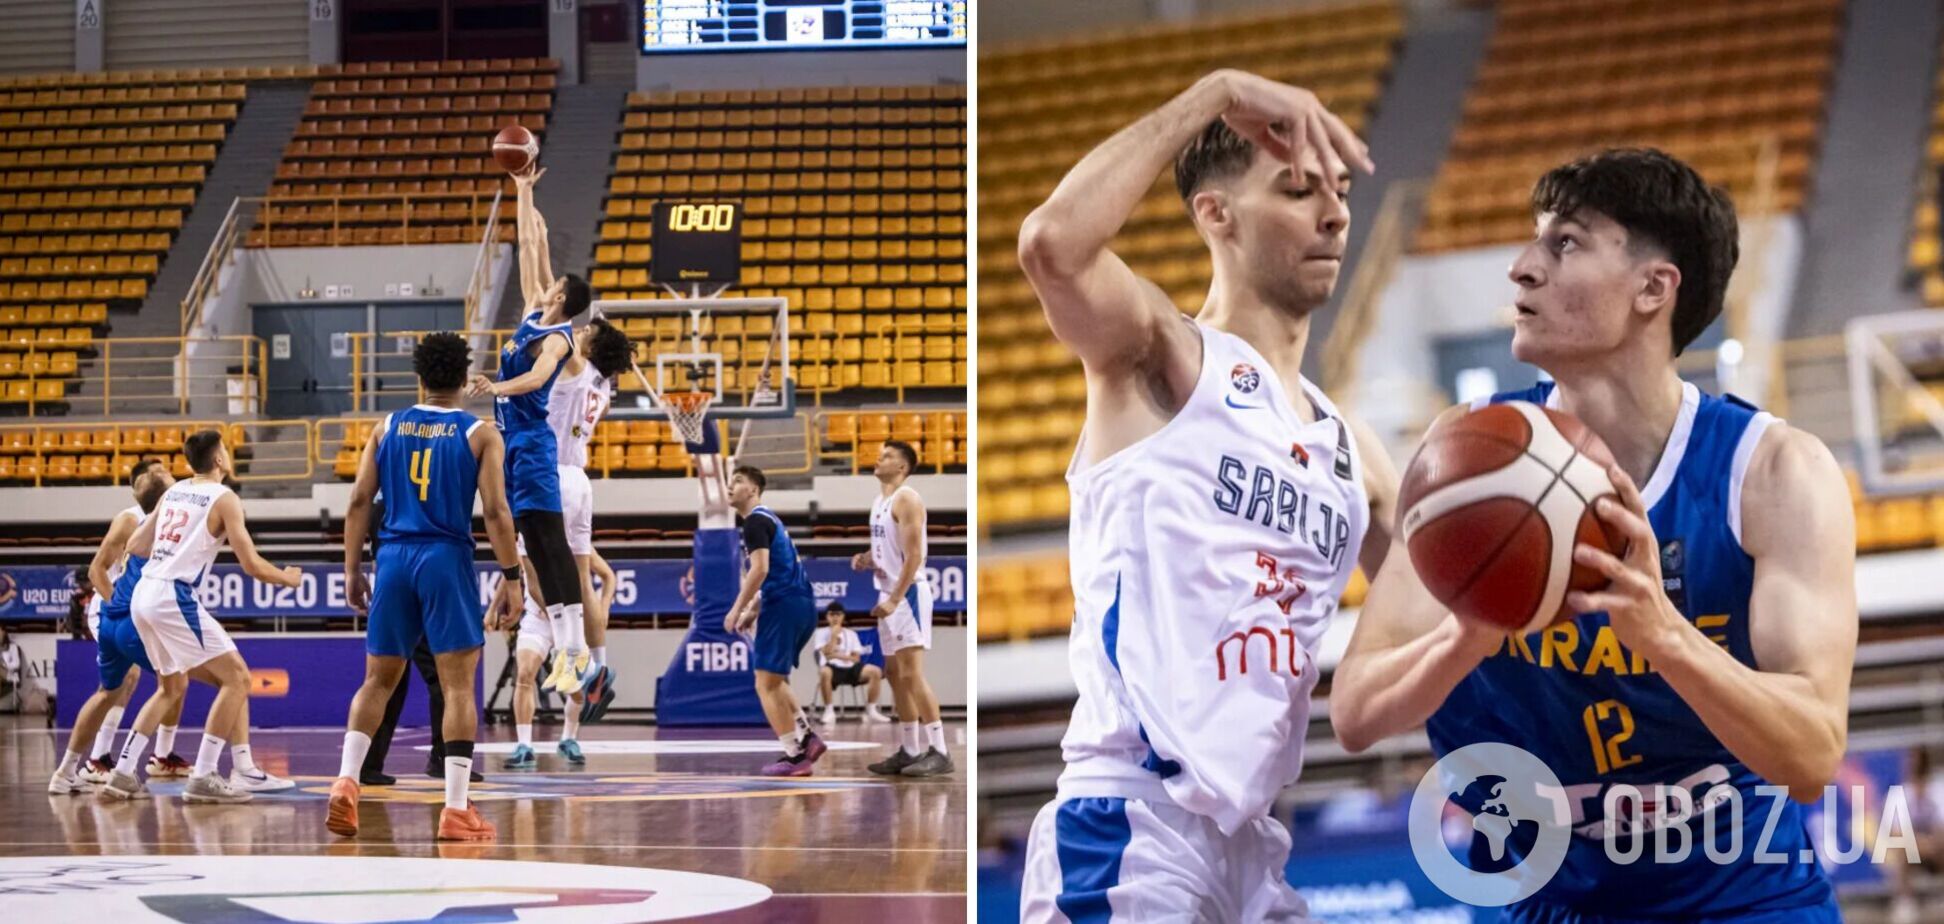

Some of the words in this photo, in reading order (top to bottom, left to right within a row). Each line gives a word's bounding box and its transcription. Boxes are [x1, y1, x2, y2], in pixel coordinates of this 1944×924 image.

[80, 14, 98, 27] 20
[315, 5, 331, 18] 19
[668, 204, 734, 232] 10:00
[409, 447, 433, 502] 4
[158, 508, 191, 544] 22
[1213, 454, 1351, 573] SRBIJA
[23, 589, 47, 604] U20
[686, 641, 749, 672] FIBA
[1583, 699, 1643, 775] 12
